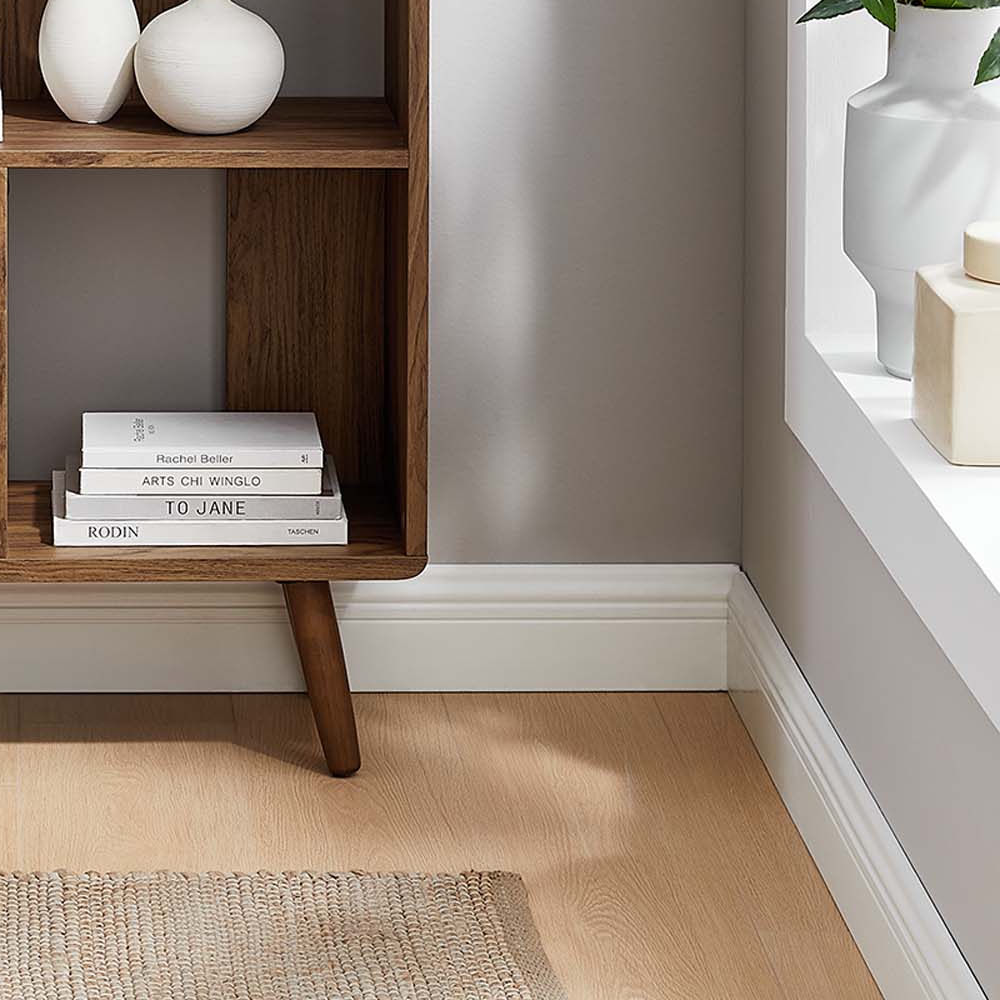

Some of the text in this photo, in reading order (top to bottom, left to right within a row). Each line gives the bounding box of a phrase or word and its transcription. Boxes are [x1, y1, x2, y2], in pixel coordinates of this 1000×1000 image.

[156, 454, 234, 465] Rachel Beller
[141, 475, 262, 488] ARTS CHI WINGLO
[164, 500, 247, 515] TO JANE
[87, 525, 140, 539] RODIN
[287, 528, 320, 536] TASCHEN
